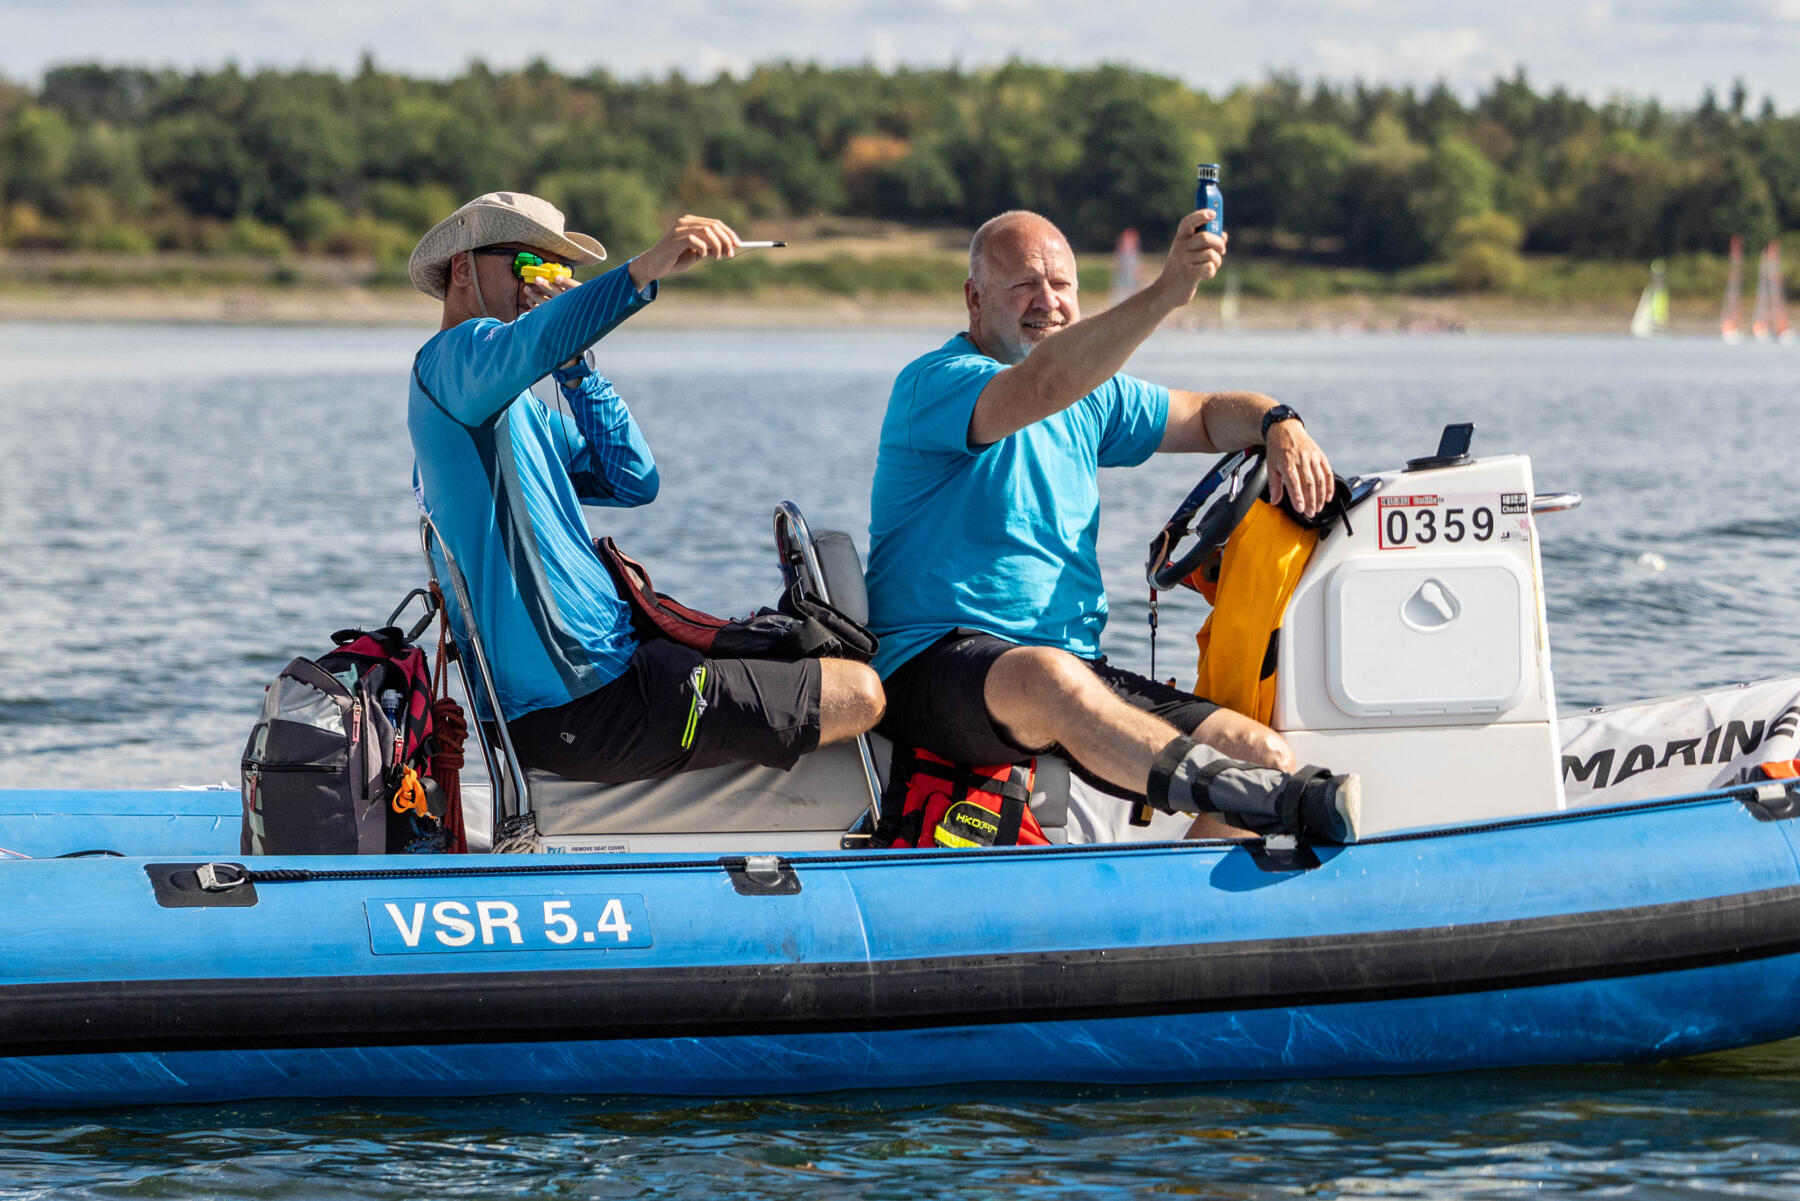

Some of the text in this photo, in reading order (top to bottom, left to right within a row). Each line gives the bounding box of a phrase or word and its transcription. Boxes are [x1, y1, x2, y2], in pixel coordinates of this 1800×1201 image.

[1386, 506, 1494, 545] 0359
[1502, 504, 1528, 513] Checked
[384, 899, 632, 947] VSR 5.4
